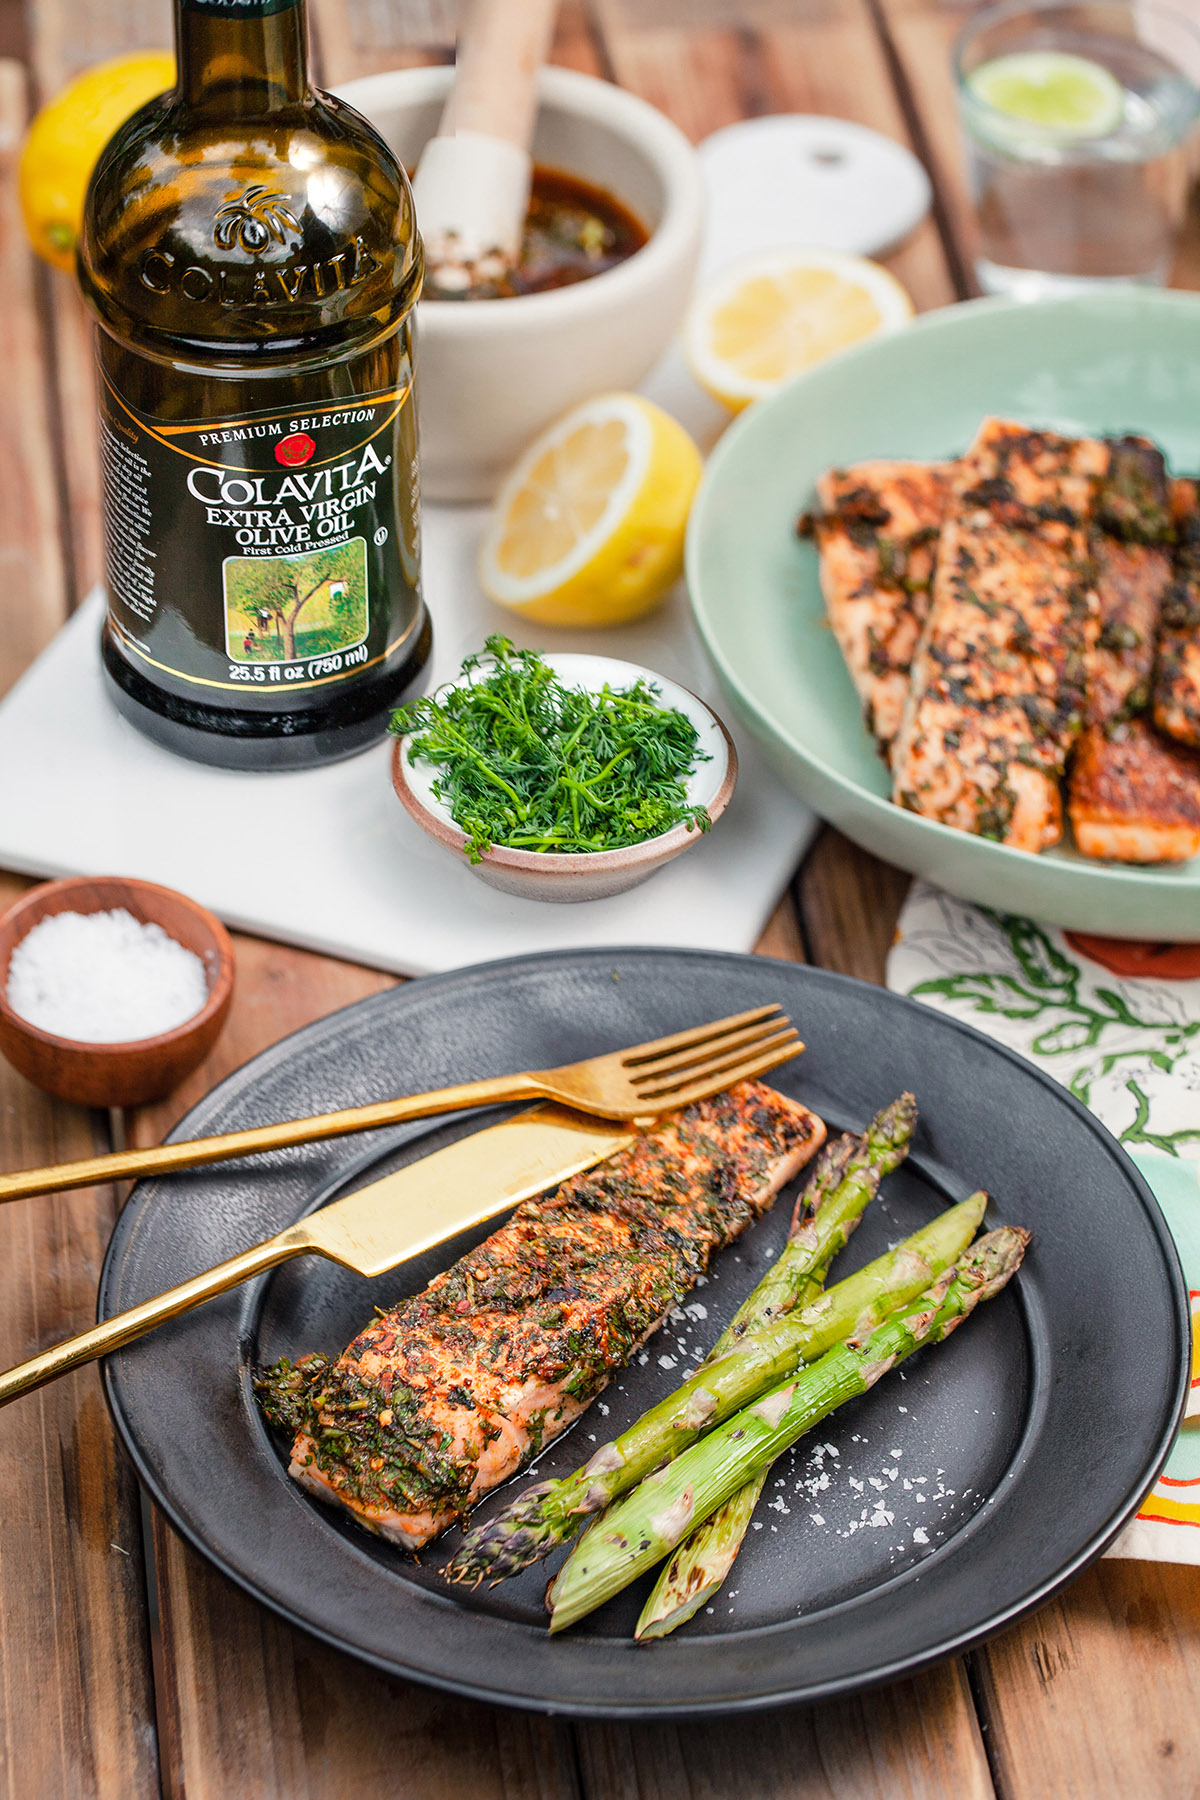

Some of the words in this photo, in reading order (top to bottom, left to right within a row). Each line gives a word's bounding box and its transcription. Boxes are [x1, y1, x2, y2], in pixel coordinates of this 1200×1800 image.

[139, 236, 383, 306] COLAVITA
[199, 423, 283, 447] PREMIUM
[289, 408, 376, 433] SELECTION
[186, 442, 390, 506] COLAVITA
[205, 506, 295, 528] EXTRA
[299, 481, 377, 523] VIRGIN
[235, 523, 311, 547] OLIVE
[316, 511, 356, 538] OIL
[242, 546, 272, 557] First
[274, 542, 302, 555] Cold
[305, 531, 349, 550] Pressed
[228, 664, 266, 682] 25.5
[267, 665, 281, 681] fl
[284, 666, 305, 680] oz
[307, 654, 343, 680] (750
[344, 644, 369, 667] ml)
